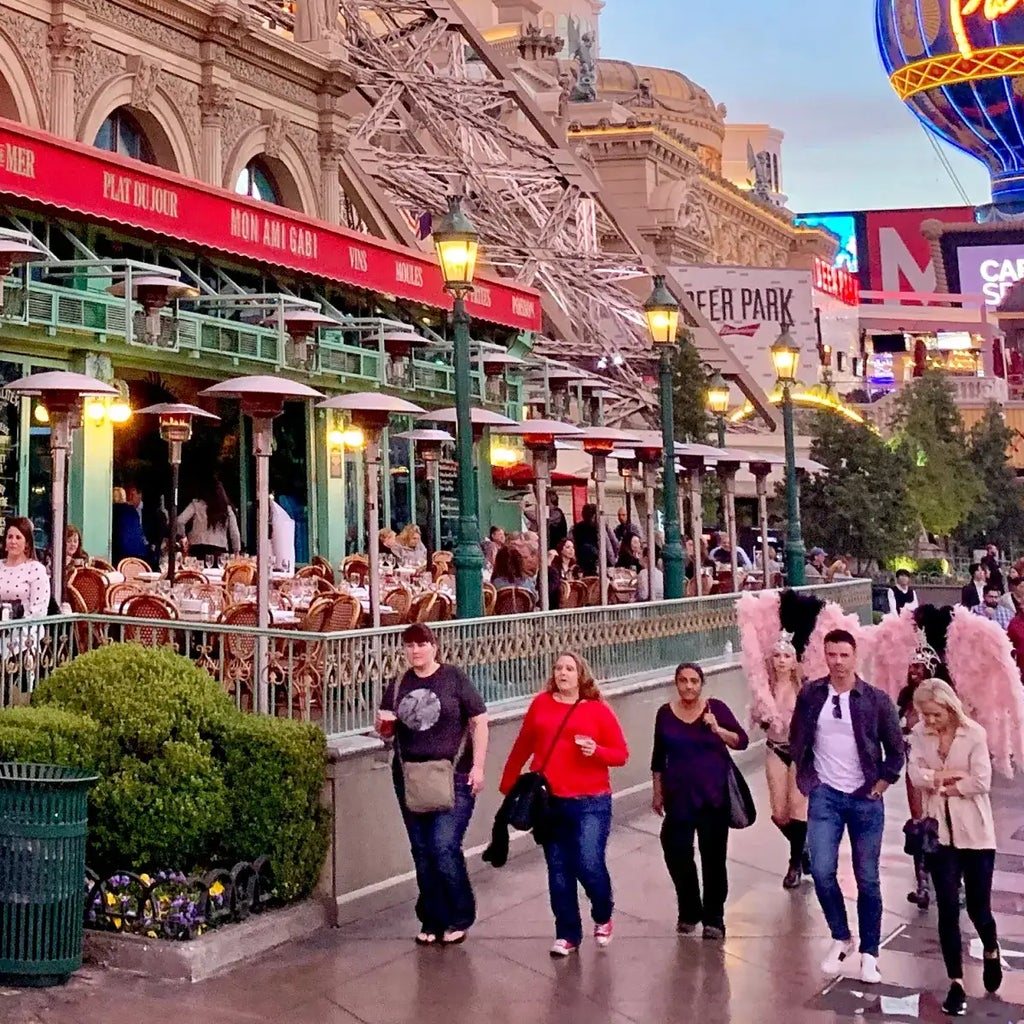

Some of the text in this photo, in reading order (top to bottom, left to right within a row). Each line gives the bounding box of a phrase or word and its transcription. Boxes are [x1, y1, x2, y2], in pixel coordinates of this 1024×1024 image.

[6, 143, 36, 178] MER
[103, 171, 131, 204] PLAT
[230, 207, 318, 259] MON AMI GABI
[348, 246, 368, 272] VINS
[741, 287, 795, 327] PARK
